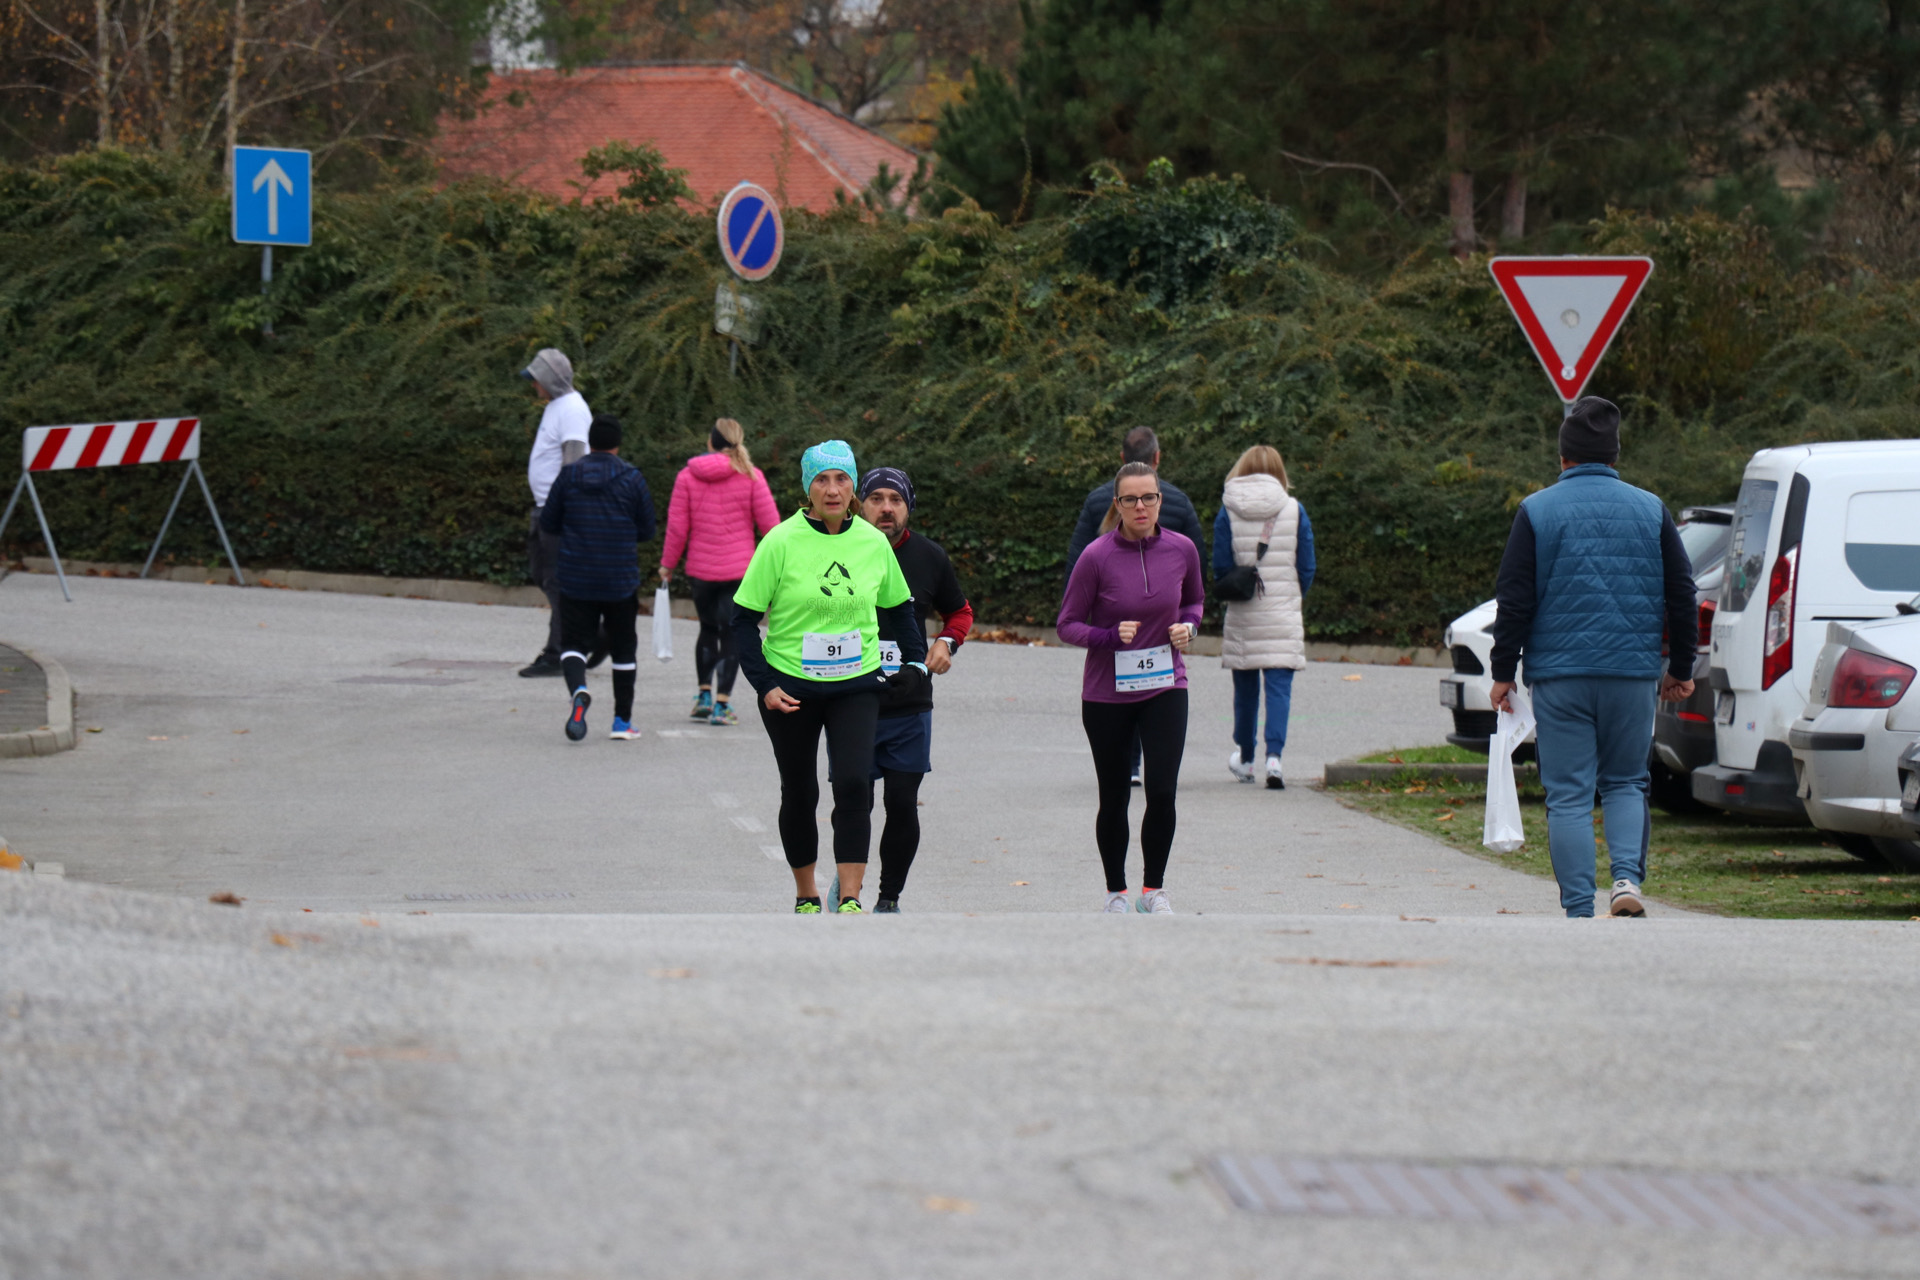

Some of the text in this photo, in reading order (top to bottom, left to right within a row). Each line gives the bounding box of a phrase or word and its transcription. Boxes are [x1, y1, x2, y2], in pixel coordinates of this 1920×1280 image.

[806, 596, 867, 612] SRETNA
[817, 610, 857, 625] TRKA
[827, 644, 842, 657] 91
[1137, 658, 1154, 670] 45
